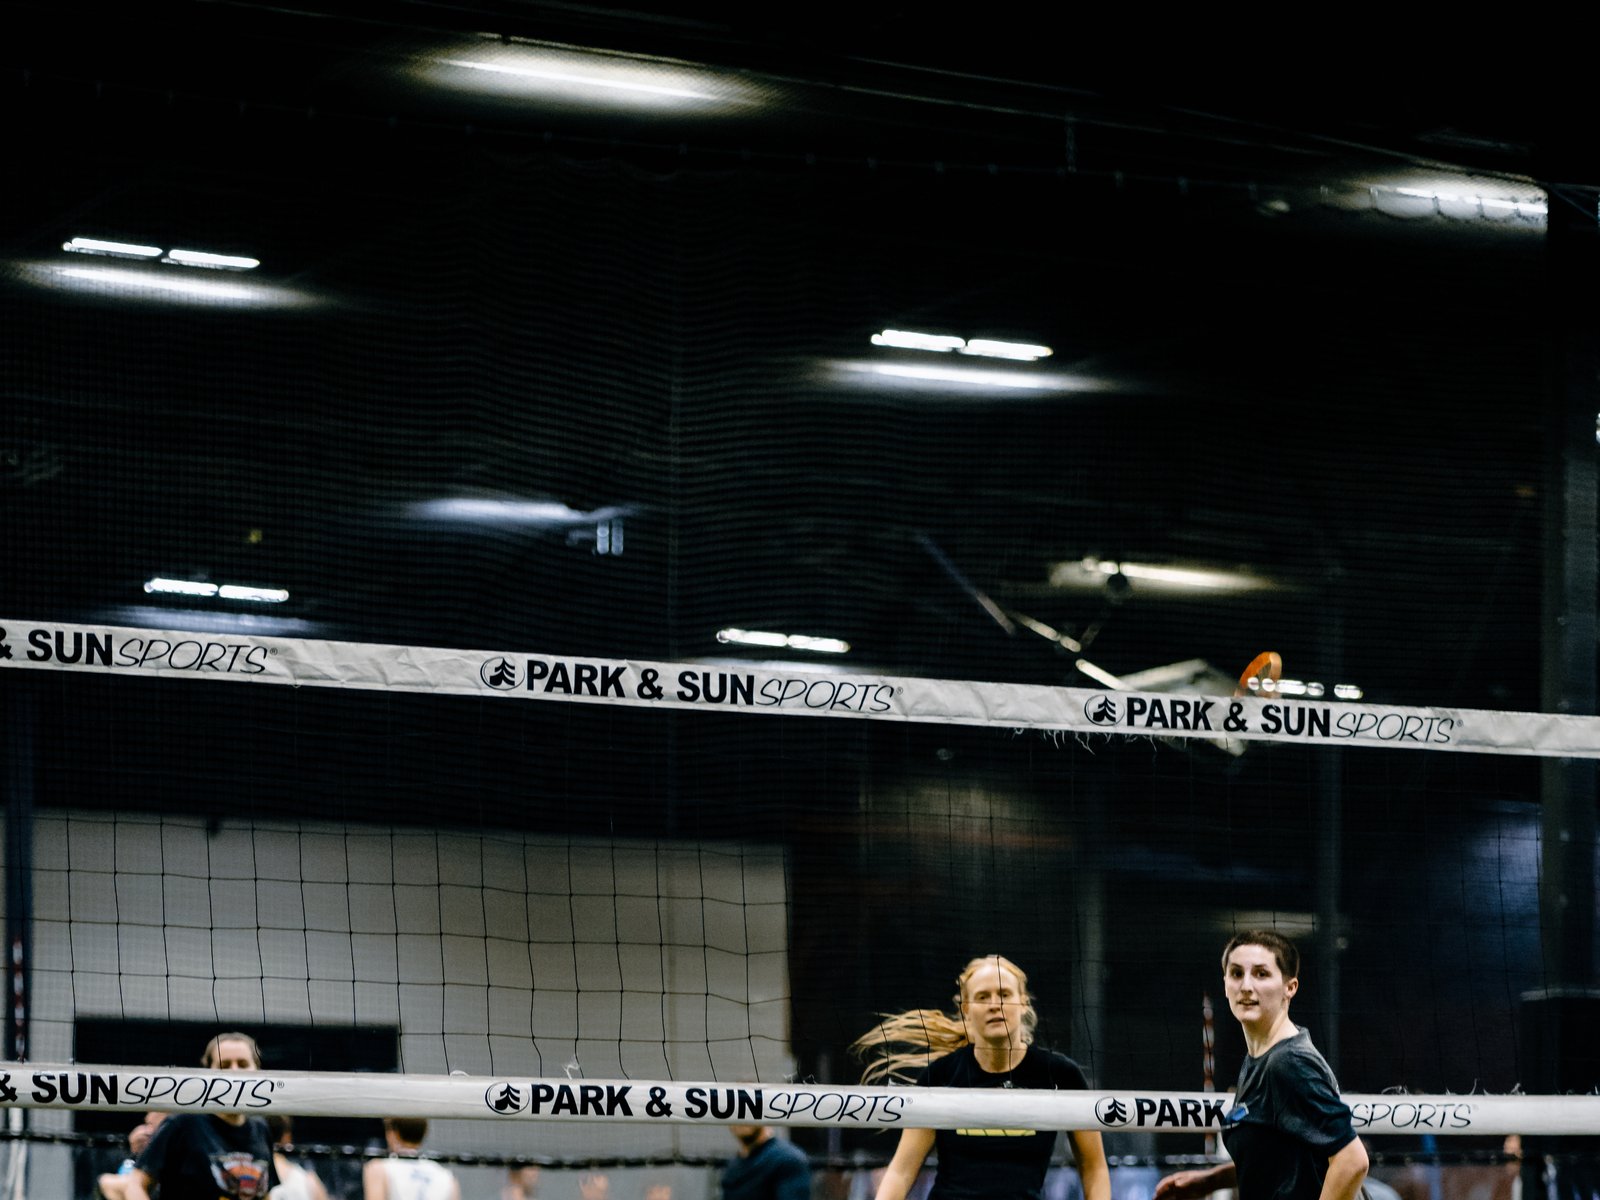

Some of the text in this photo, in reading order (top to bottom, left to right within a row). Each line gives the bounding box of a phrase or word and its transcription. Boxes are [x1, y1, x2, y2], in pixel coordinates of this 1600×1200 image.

[527, 659, 626, 698] PARK
[637, 668, 664, 700] &
[1126, 697, 1214, 732] PARK
[1223, 702, 1248, 733] &
[531, 1083, 633, 1117] PARK
[645, 1086, 673, 1118] &
[1135, 1098, 1226, 1127] PARK
